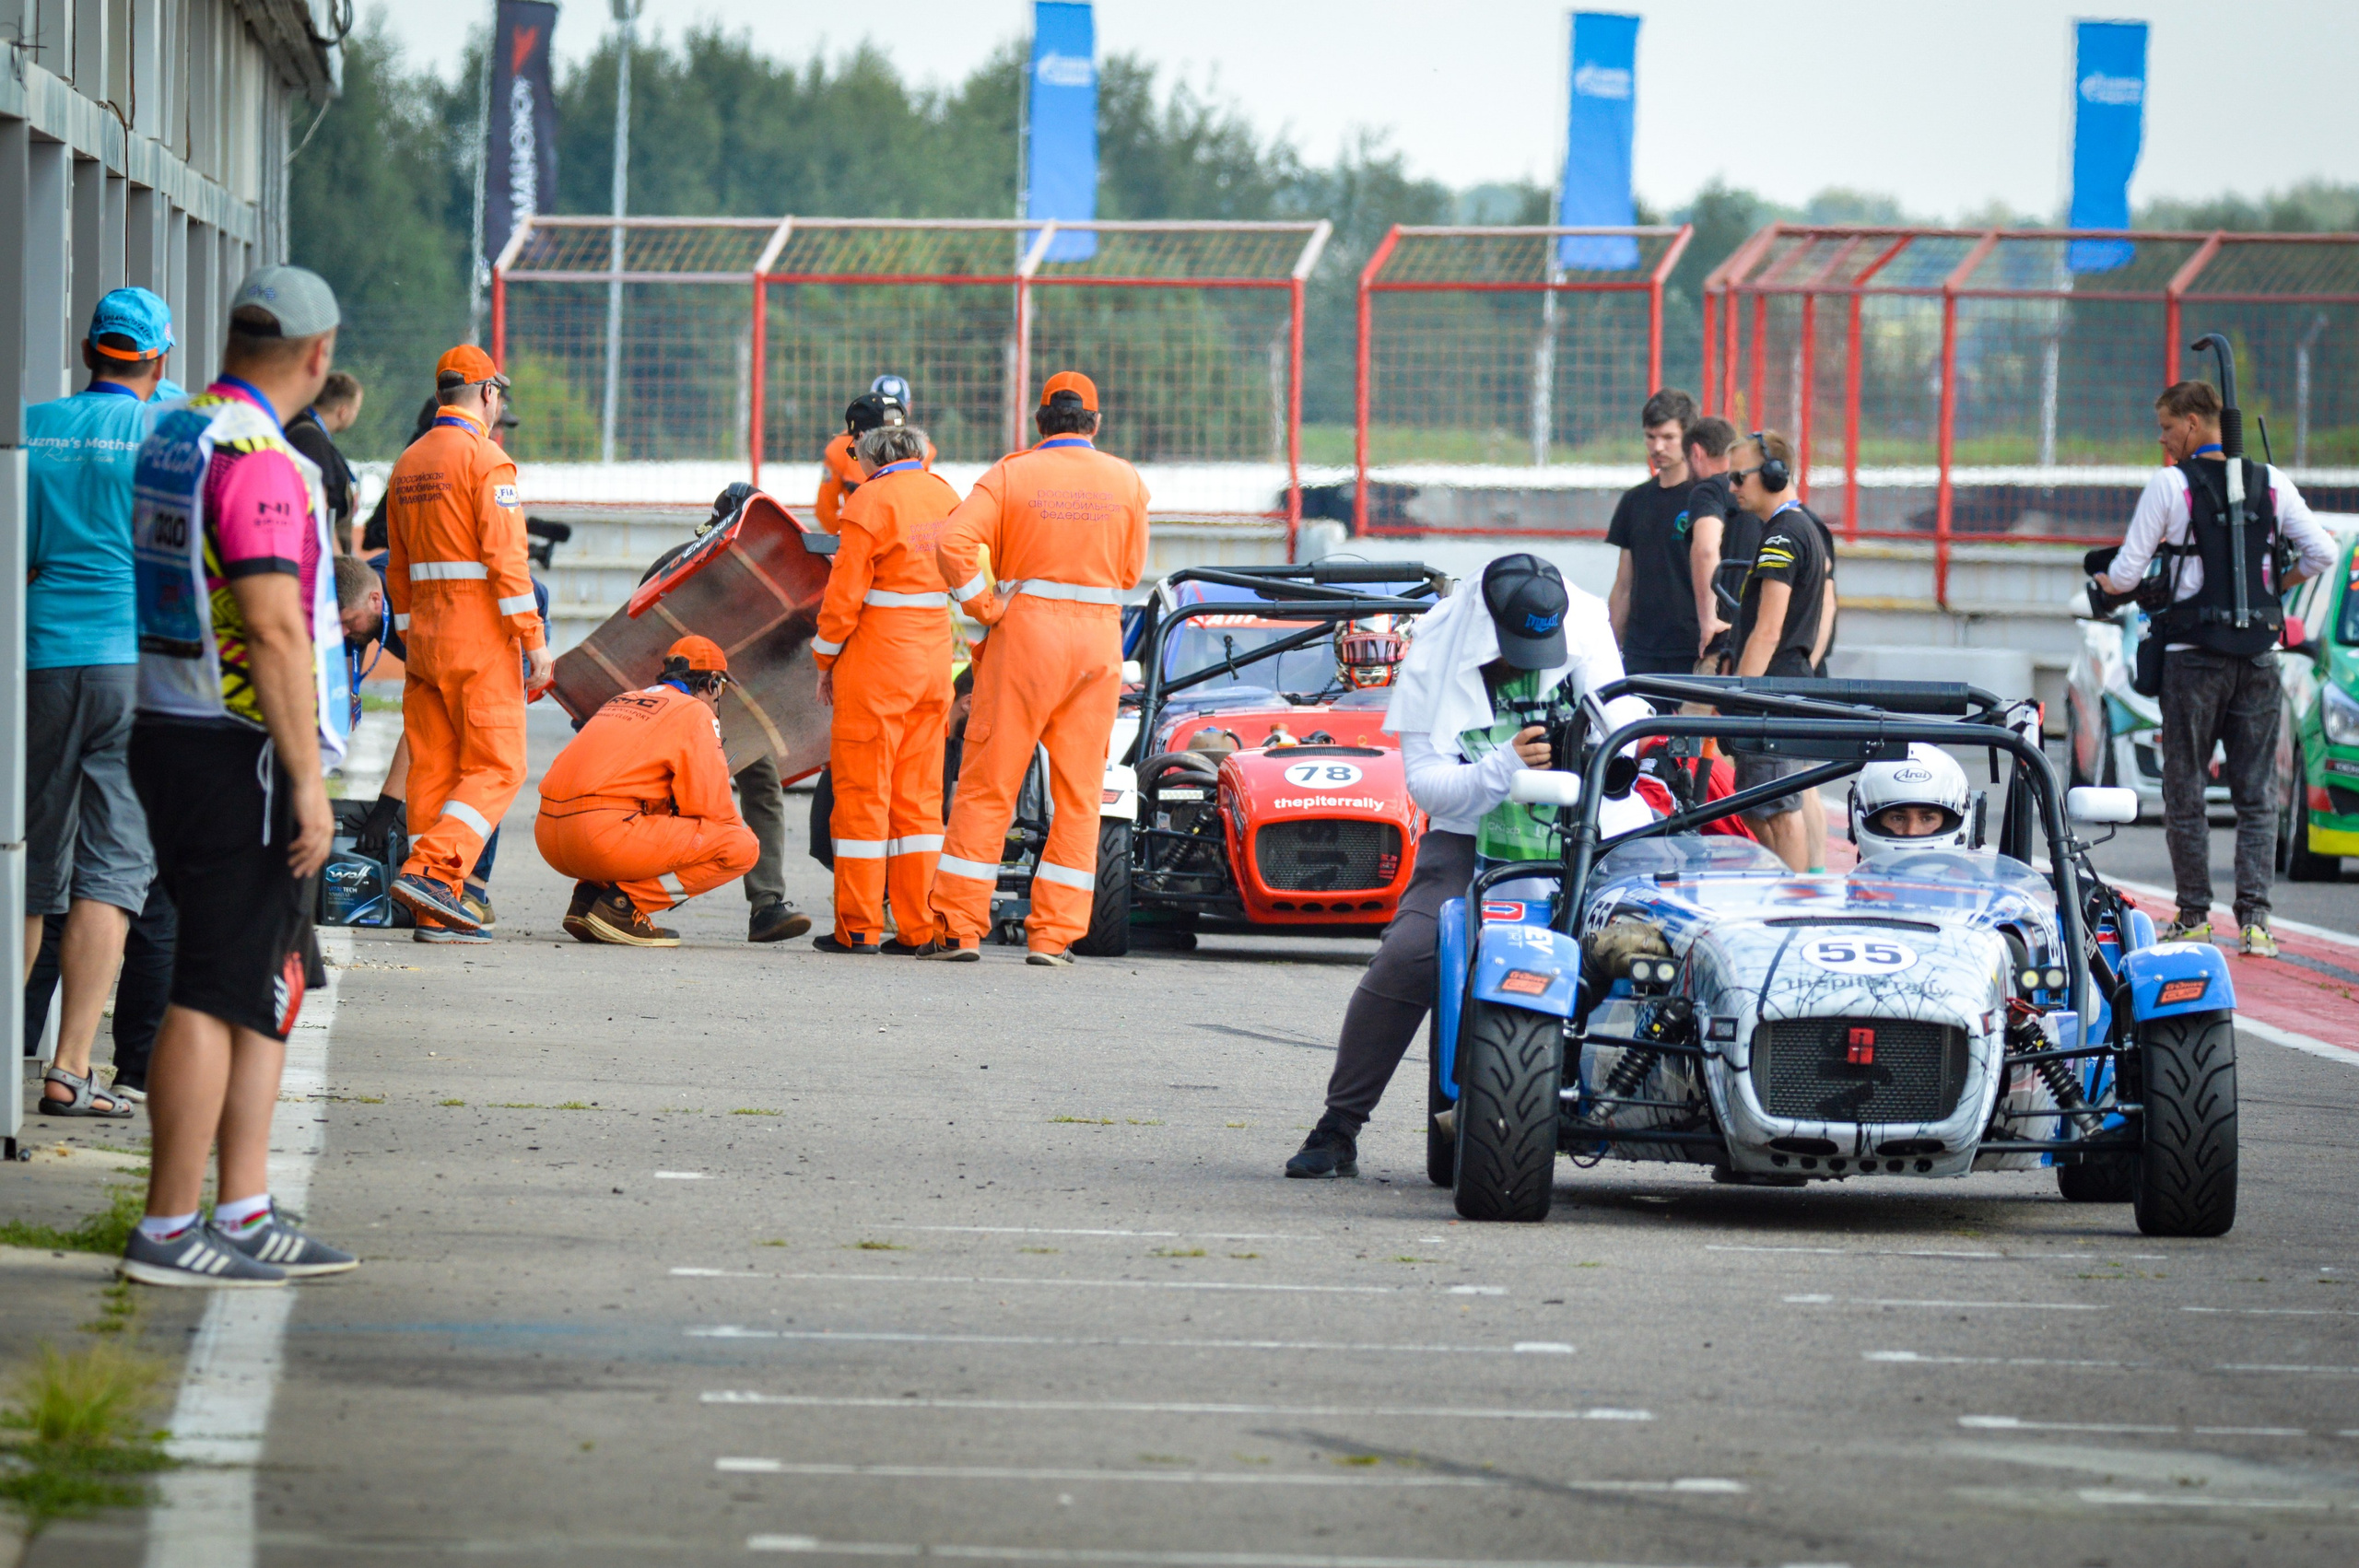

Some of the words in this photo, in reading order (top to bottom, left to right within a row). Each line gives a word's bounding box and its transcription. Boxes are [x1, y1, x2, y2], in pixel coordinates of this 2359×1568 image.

[27, 436, 82, 450] uzma's
[500, 488, 514, 497] FIA
[1038, 488, 1114, 501] российская
[1028, 499, 1121, 513] автомобильная
[1039, 509, 1109, 522] федерация
[1525, 613, 1558, 627] EVERLAST
[1295, 766, 1352, 781] 78
[1896, 768, 1928, 779] Arai
[1273, 795, 1385, 812] thepiterrally
[330, 865, 373, 886] wolf
[1818, 942, 1903, 965] 55
